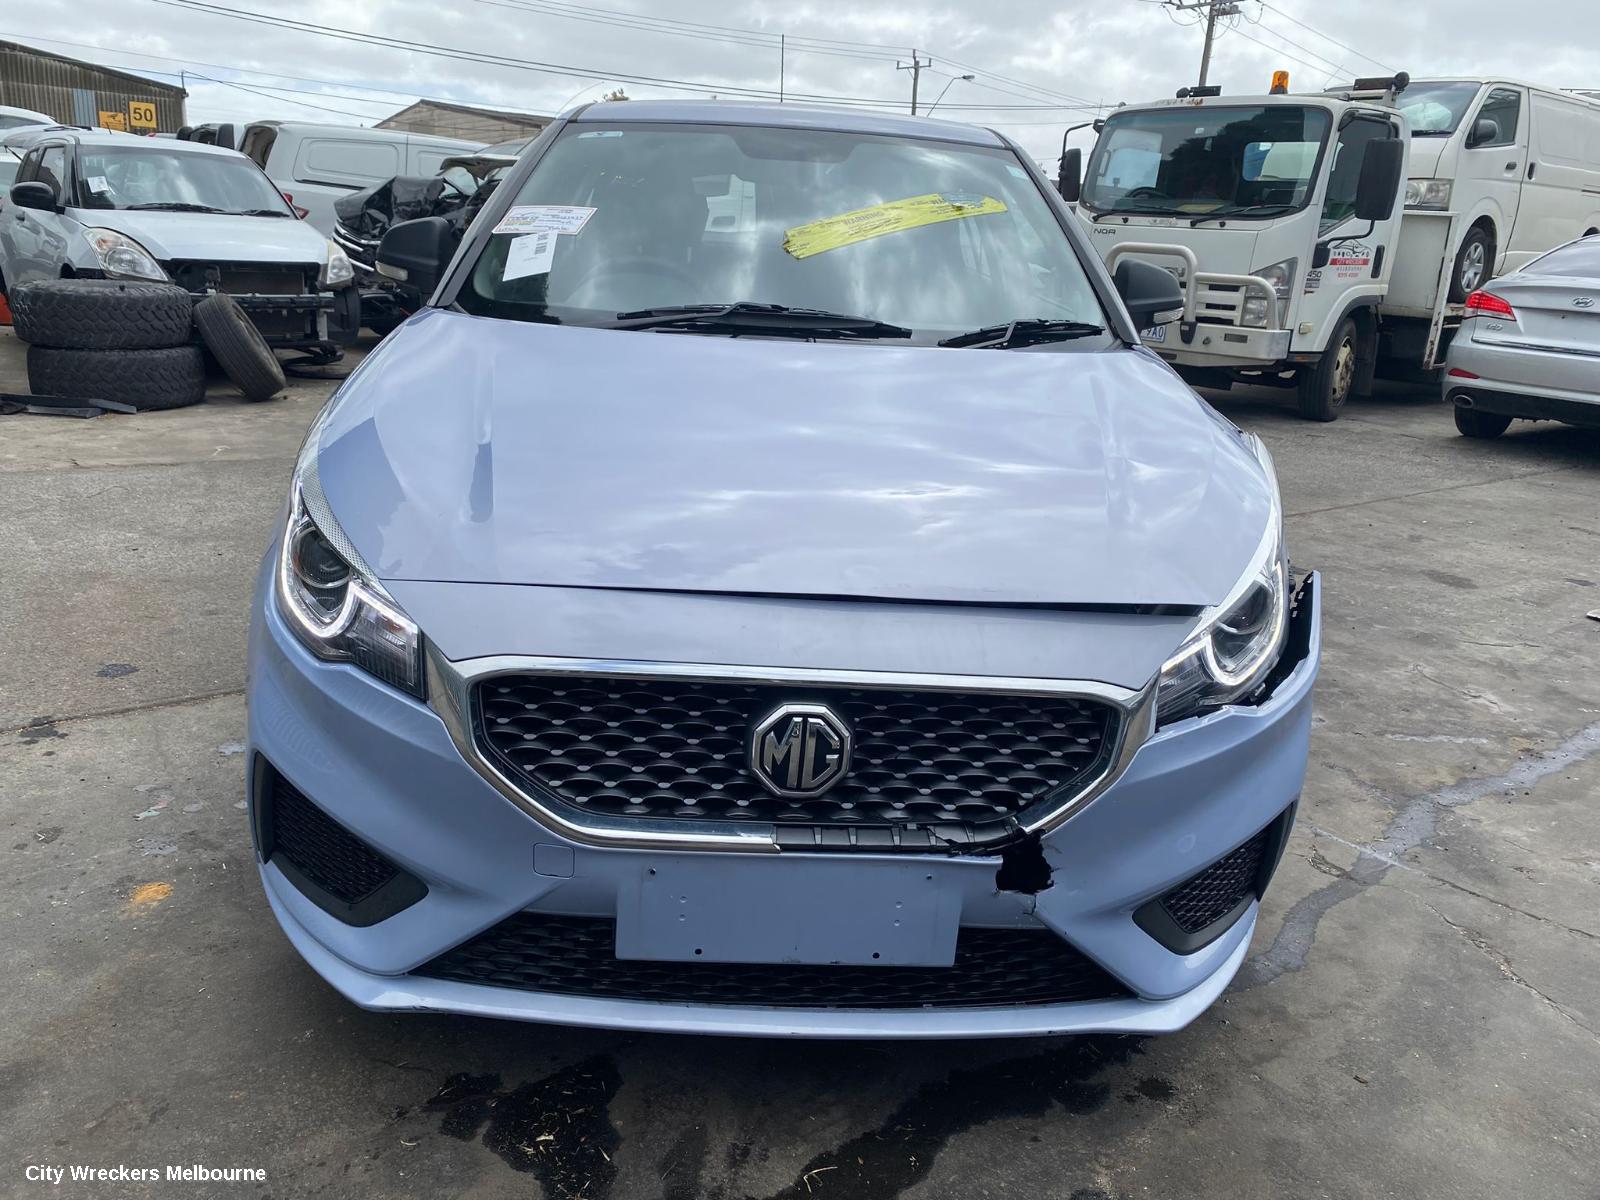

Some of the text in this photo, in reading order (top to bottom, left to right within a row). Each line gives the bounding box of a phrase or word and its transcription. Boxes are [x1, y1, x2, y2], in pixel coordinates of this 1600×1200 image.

[133, 107, 153, 122] 50
[1306, 270, 1322, 278] 450
[763, 717, 840, 789] MG
